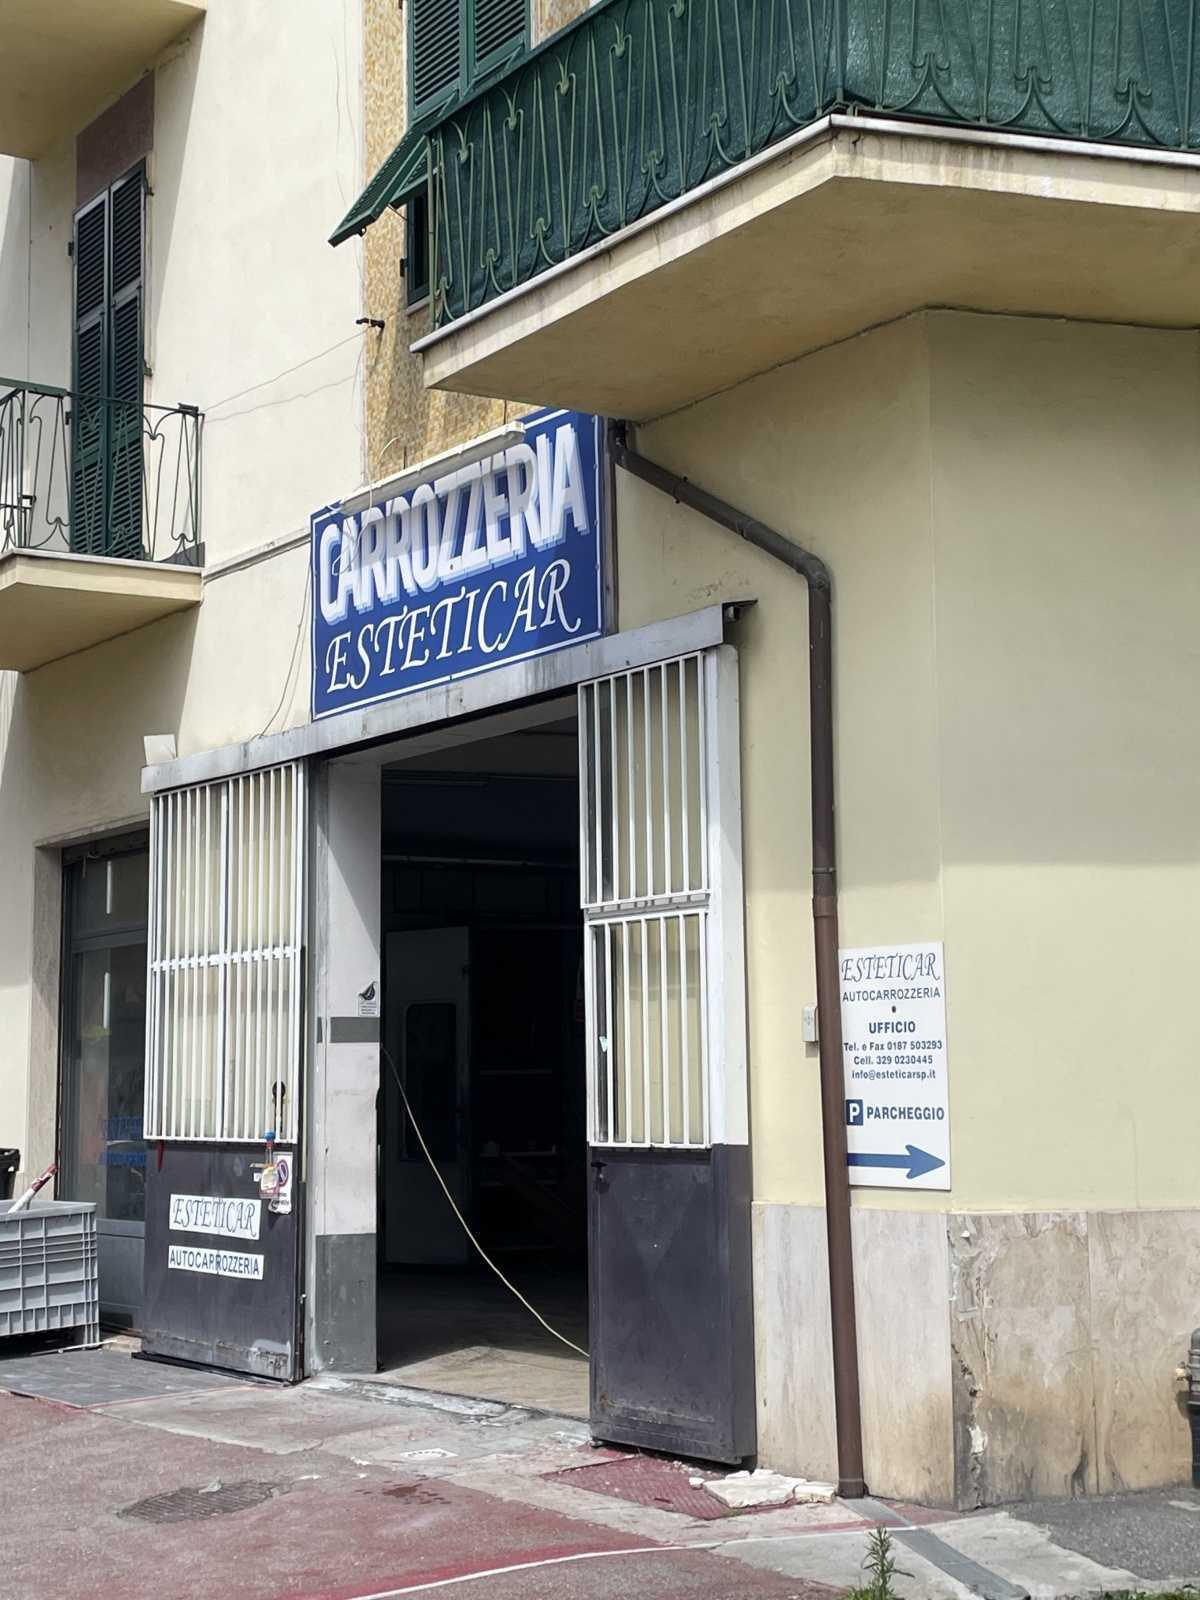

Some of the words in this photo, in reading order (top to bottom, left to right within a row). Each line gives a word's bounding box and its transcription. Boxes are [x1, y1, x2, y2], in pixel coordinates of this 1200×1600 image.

[320, 423, 588, 625] CARROZZERIA
[326, 558, 582, 694] ESTETICAR
[841, 952, 941, 983] ESTETICAR
[842, 987, 941, 1002] AUTOCARROZZERIA
[868, 1021, 916, 1034] UFFICIO
[843, 1042, 860, 1052] Tel.
[862, 1043, 867, 1051] e
[869, 1041, 885, 1051] Fax
[887, 1041, 908, 1051] 0187
[853, 1056, 874, 1065] Cell.
[876, 1055, 892, 1065] 329
[894, 1055, 933, 1065] 0230445
[851, 1069, 936, 1081] info@esteticarsp.it
[849, 1102, 860, 1123] P
[866, 1106, 945, 1120] PARCHEGGIO
[172, 1197, 258, 1238] ESTETICAR
[169, 1249, 260, 1276] AUTOCARROZZERIA
